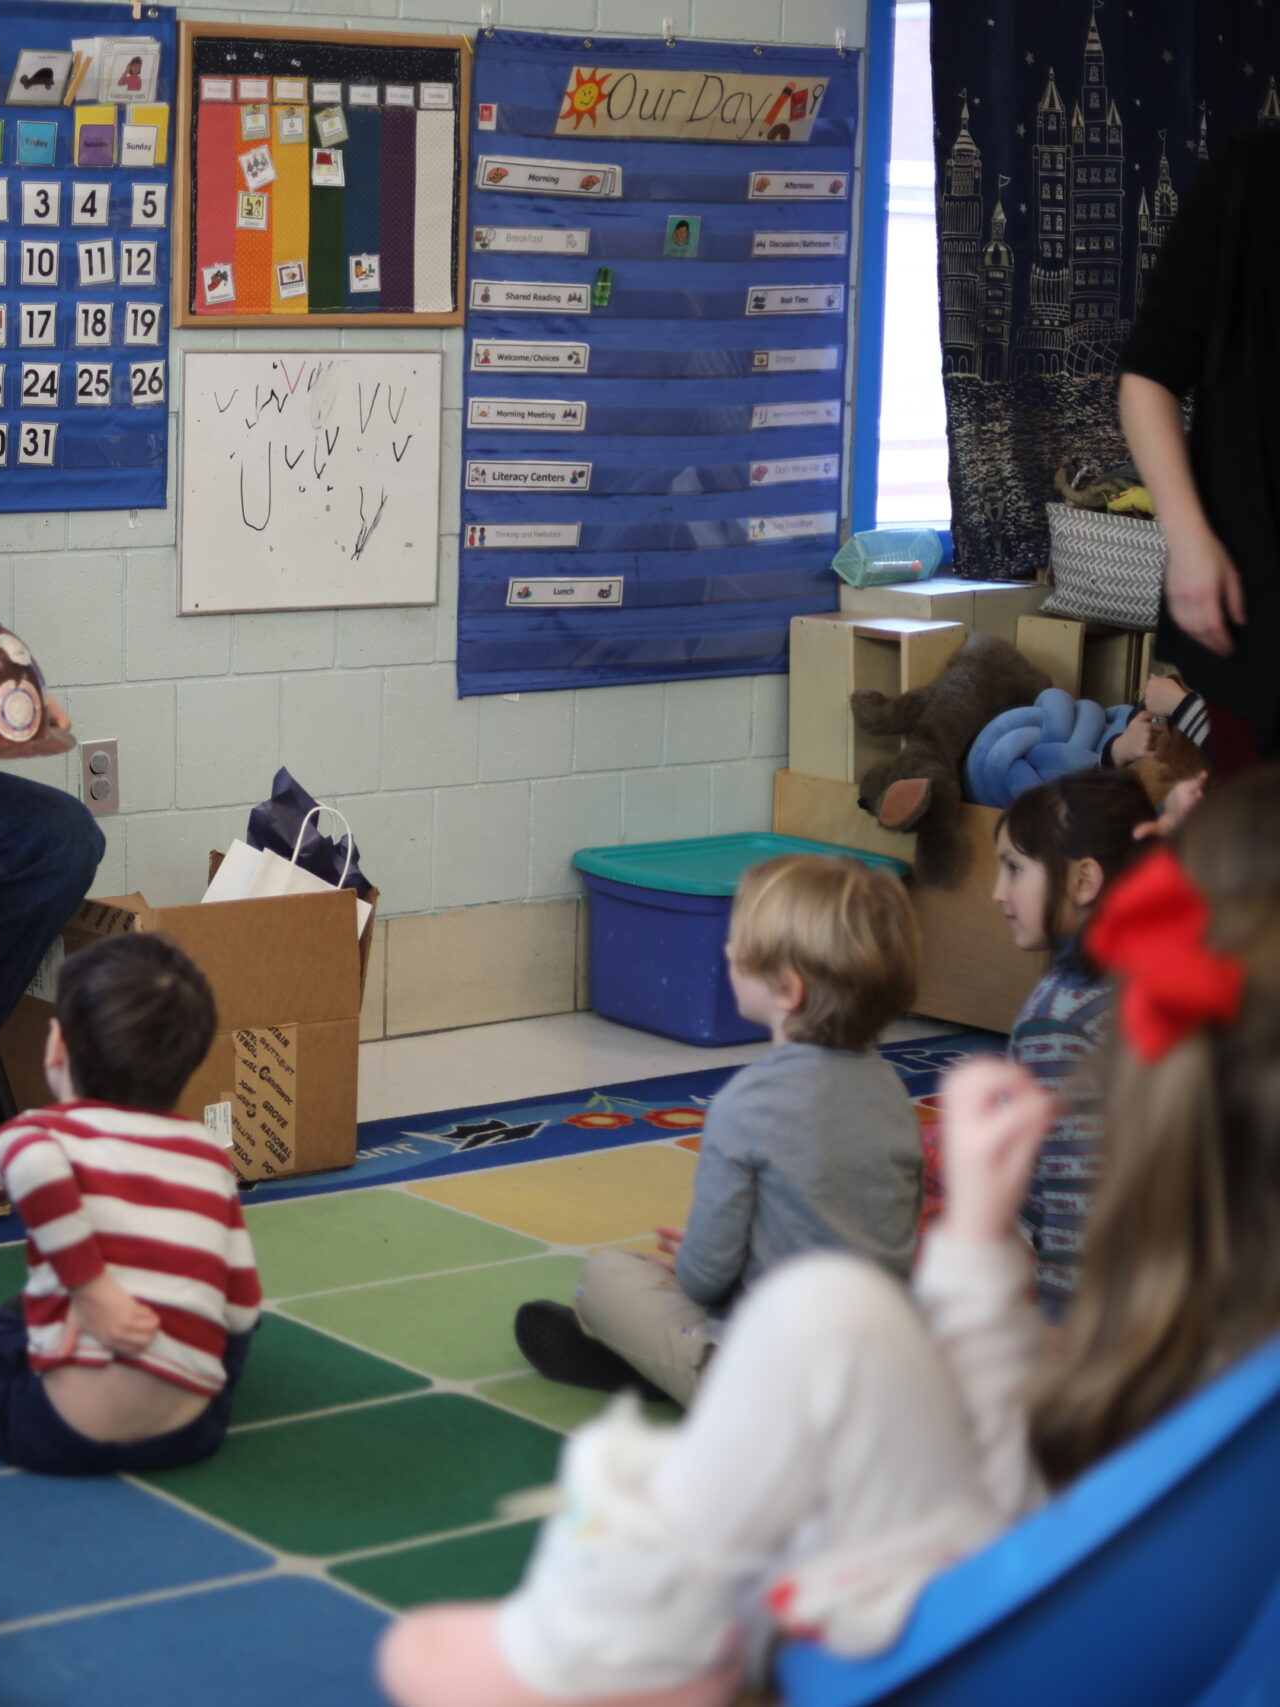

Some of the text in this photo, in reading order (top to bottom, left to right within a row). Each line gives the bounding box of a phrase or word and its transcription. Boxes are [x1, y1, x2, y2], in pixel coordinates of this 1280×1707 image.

[606, 72, 686, 122] Our
[25, 138, 49, 148] Friday
[126, 142, 152, 151] Sunday
[527, 173, 560, 185] Morning
[784, 181, 814, 190] Afternoon
[33, 189, 50, 219] 3
[80, 190, 97, 218] 4
[142, 190, 158, 219] 5
[505, 232, 544, 243] Breakfast
[25, 247, 54, 277] 10
[84, 247, 106, 276] 11
[124, 247, 152, 276] 12
[505, 292, 562, 303] Shared Reading
[25, 310, 52, 338] 17
[82, 308, 107, 337] 18
[131, 308, 157, 337] 19
[496, 353, 560, 362] Welcome/Choices
[23, 369, 58, 398] 24
[78, 368, 111, 397] 25
[131, 366, 163, 396] 26
[496, 410, 556, 420] Morning Meeting
[22, 428, 52, 457] 31
[492, 472, 566, 483] Literacy Centers
[553, 587, 575, 596] Lunch
[262, 1100, 288, 1129] GROVE
[260, 1122, 293, 1158] NATIONAL
[264, 1139, 289, 1165] CRANE
